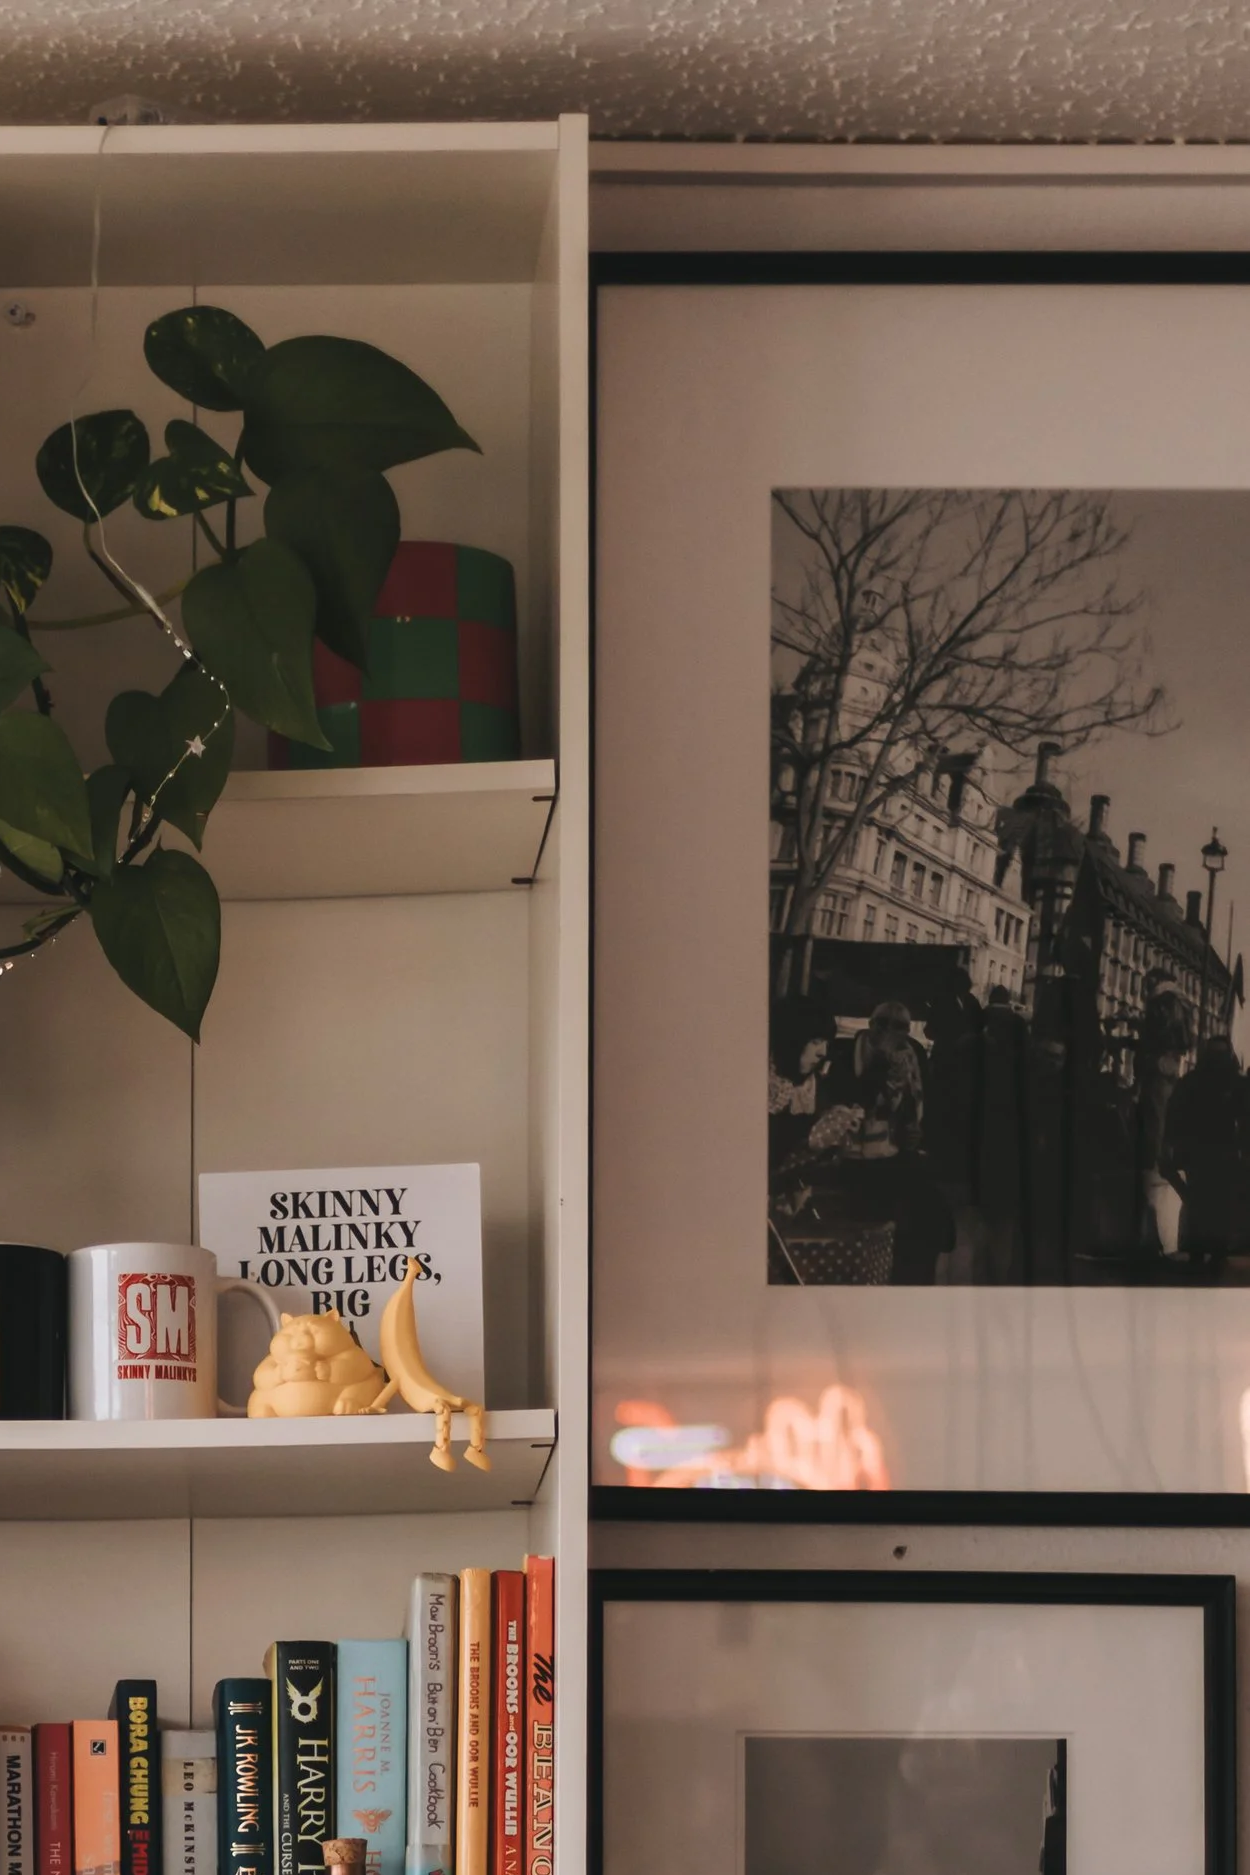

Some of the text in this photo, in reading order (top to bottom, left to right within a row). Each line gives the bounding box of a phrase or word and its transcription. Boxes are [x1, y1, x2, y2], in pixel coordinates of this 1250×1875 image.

[269, 1187, 408, 1220] SKINNY
[257, 1220, 422, 1254] MALINKY
[238, 1252, 442, 1287] LONG LEGS,
[125, 1282, 189, 1356] SM
[311, 1288, 371, 1318] BIG
[117, 1364, 197, 1383] SKINNY MALINKYS
[429, 1593, 444, 1622] Maw
[428, 1623, 445, 1672] Broon's
[533, 1652, 555, 1706] The
[352, 1675, 377, 1794] HARRIS
[379, 1692, 392, 1776] JOANNE M.
[426, 1727, 445, 1754] Ben
[468, 1641, 480, 1808] THE BROONS AND OOR WULLIE
[504, 1620, 519, 1837] THE BROONS and OOR WULLIE
[128, 1696, 150, 1826] BORA CHUNG
[183, 1761, 195, 1792] LEO
[6, 1754, 23, 1858] MARATHON
[236, 1752, 260, 1833] ROWLING
[282, 1793, 290, 1812] AND
[297, 1738, 329, 1852] HARRY
[425, 1761, 446, 1830] Cookbook
[282, 1815, 290, 1830] THE
[49, 1841, 61, 1865] THE
[505, 1844, 517, 1855] A
